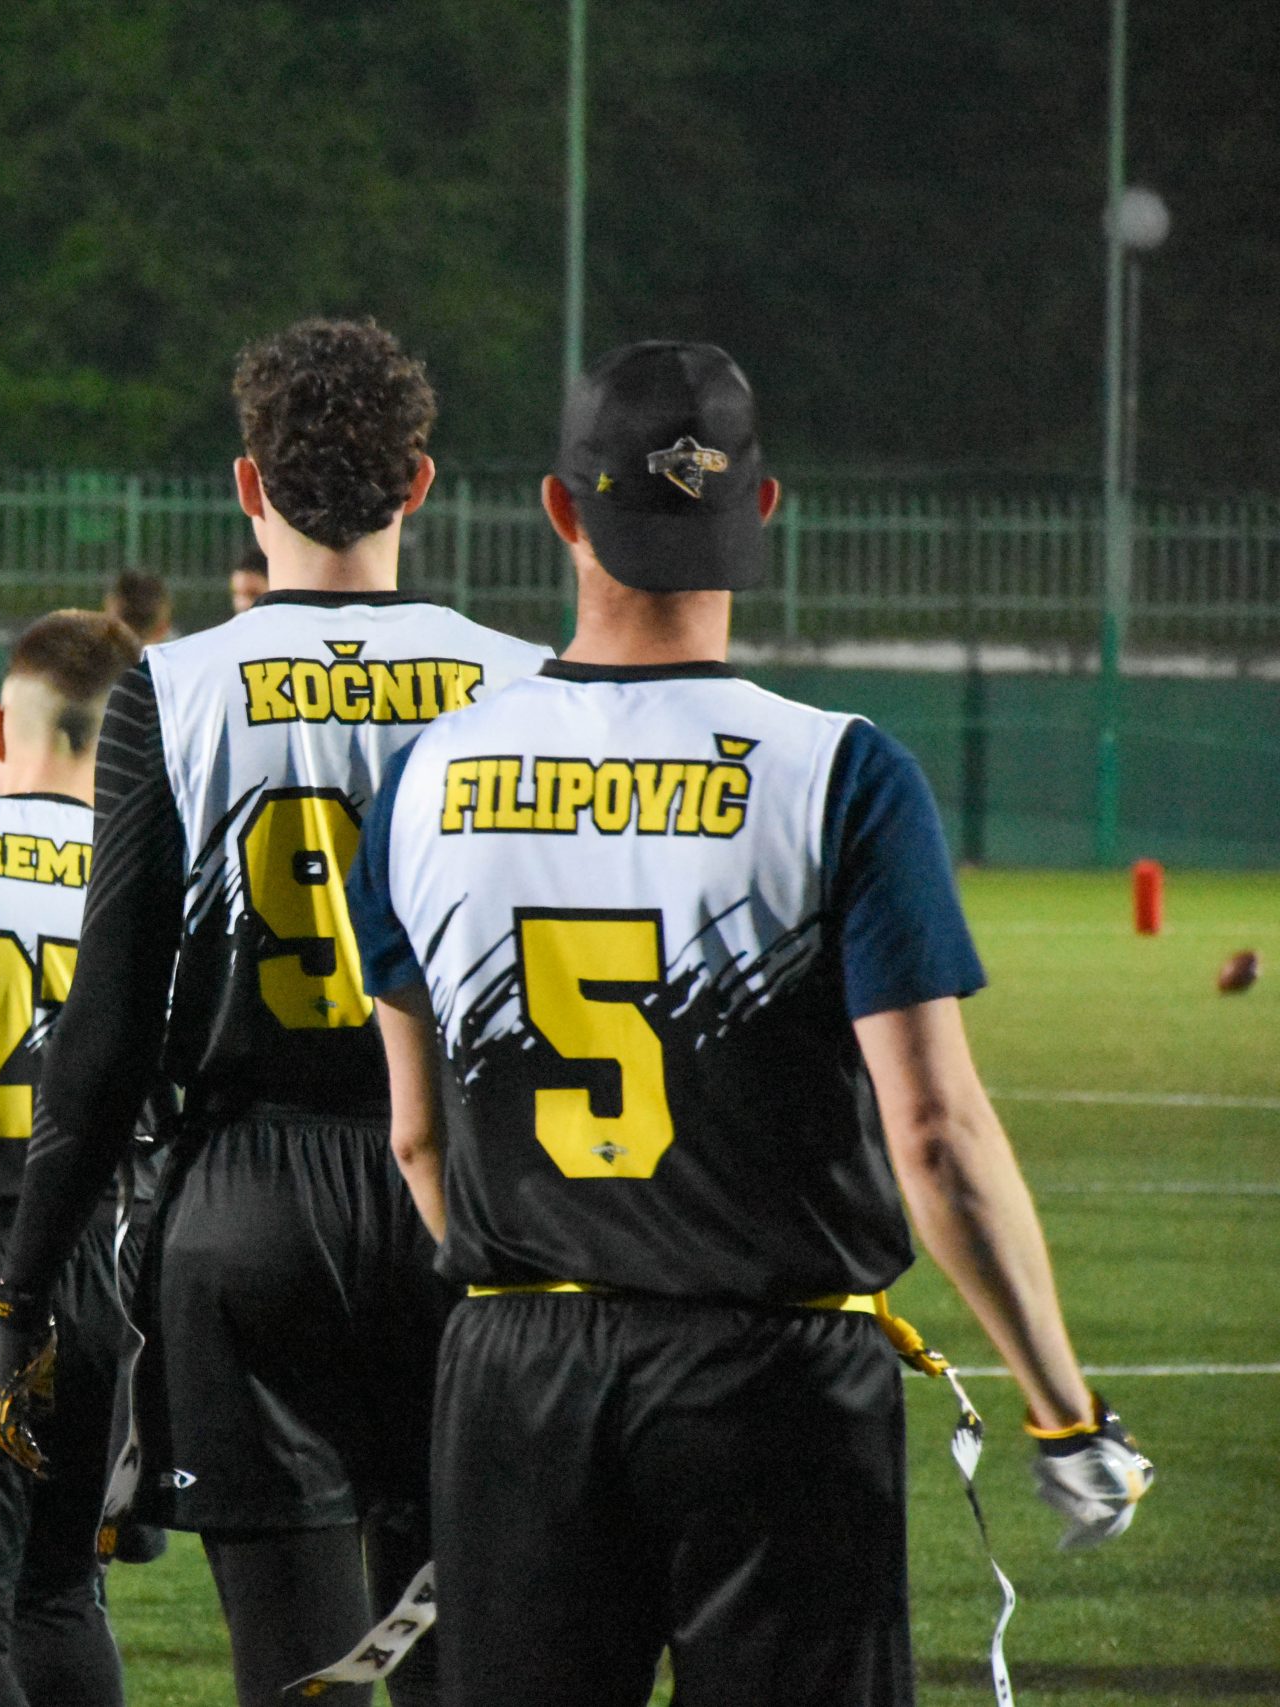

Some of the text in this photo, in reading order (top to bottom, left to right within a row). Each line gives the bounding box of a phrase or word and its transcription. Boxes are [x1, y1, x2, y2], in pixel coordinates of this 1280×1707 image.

[239, 640, 484, 726] KOČNIK
[441, 733, 761, 838] FILIPOVIČ
[238, 786, 374, 1030] 9
[513, 907, 674, 1179] 5
